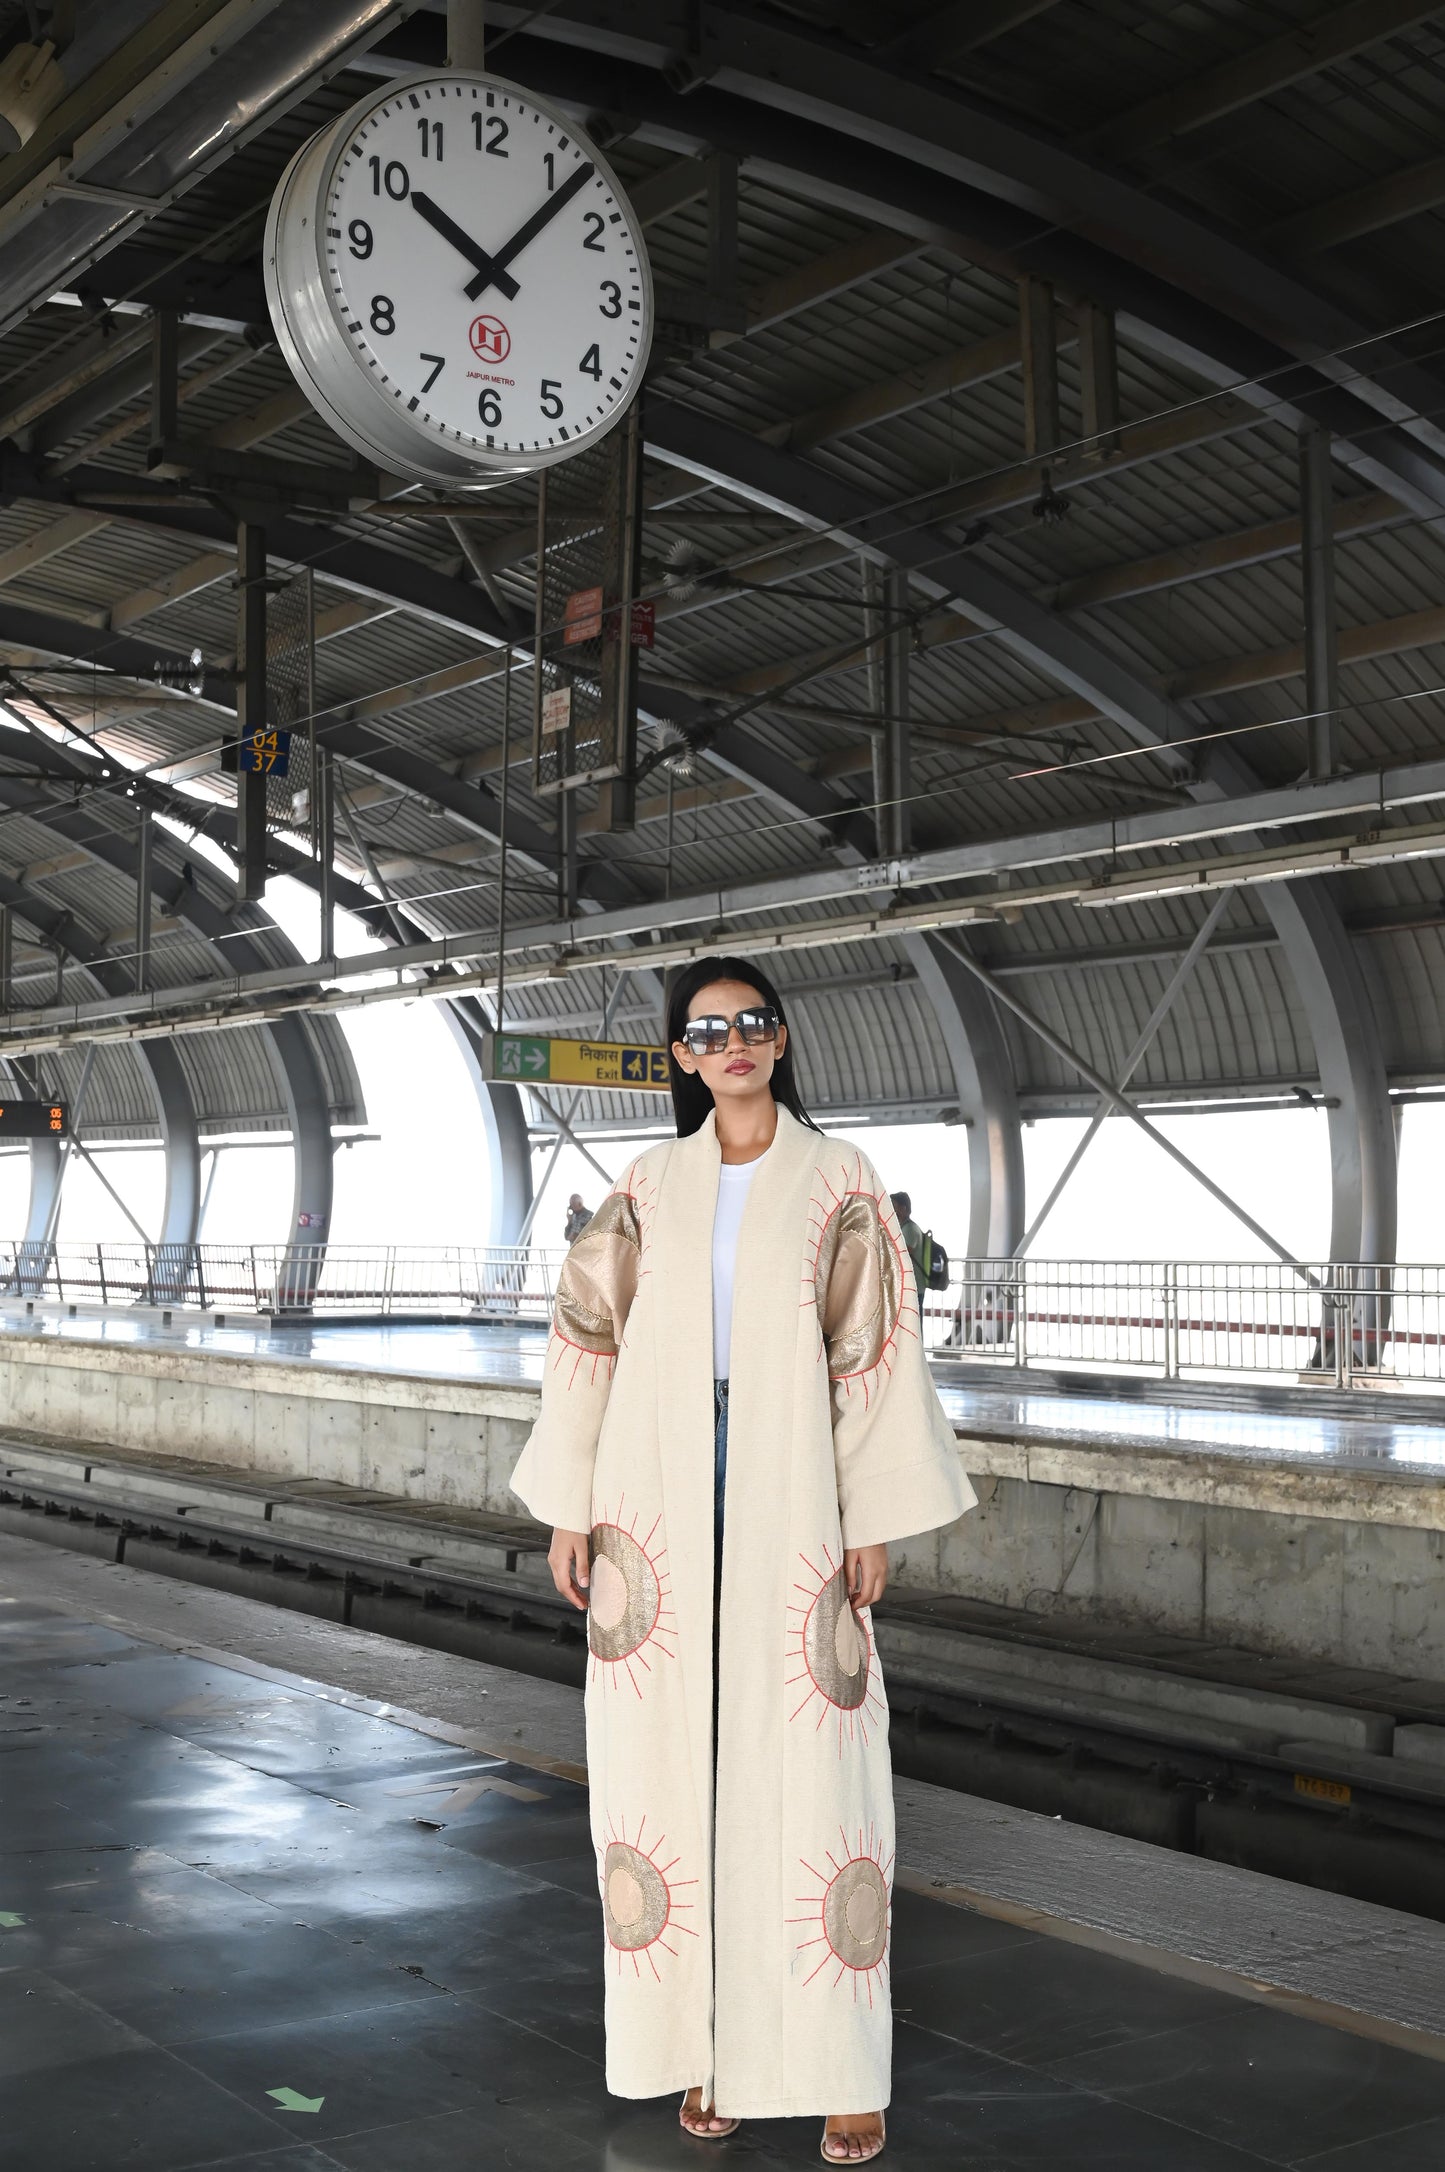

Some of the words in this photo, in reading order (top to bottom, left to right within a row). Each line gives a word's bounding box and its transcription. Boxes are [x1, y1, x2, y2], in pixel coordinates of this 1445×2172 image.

[417, 117, 443, 162] 11
[471, 111, 509, 158] 12
[369, 155, 410, 201] 10
[544, 152, 554, 191] 1
[348, 219, 373, 260] 9
[583, 212, 605, 253] 2
[370, 295, 395, 336] 8
[599, 280, 622, 319] 3
[420, 352, 445, 393] 7
[465, 371, 491, 381] JAIPUR
[491, 375, 516, 387] METRO
[579, 343, 602, 382] 4
[478, 388, 502, 428] 6
[540, 379, 564, 419] 5
[253, 729, 278, 751] 04
[252, 751, 278, 773] 37
[579, 1044, 619, 1062] निकास
[597, 1067, 618, 1080] Exit
